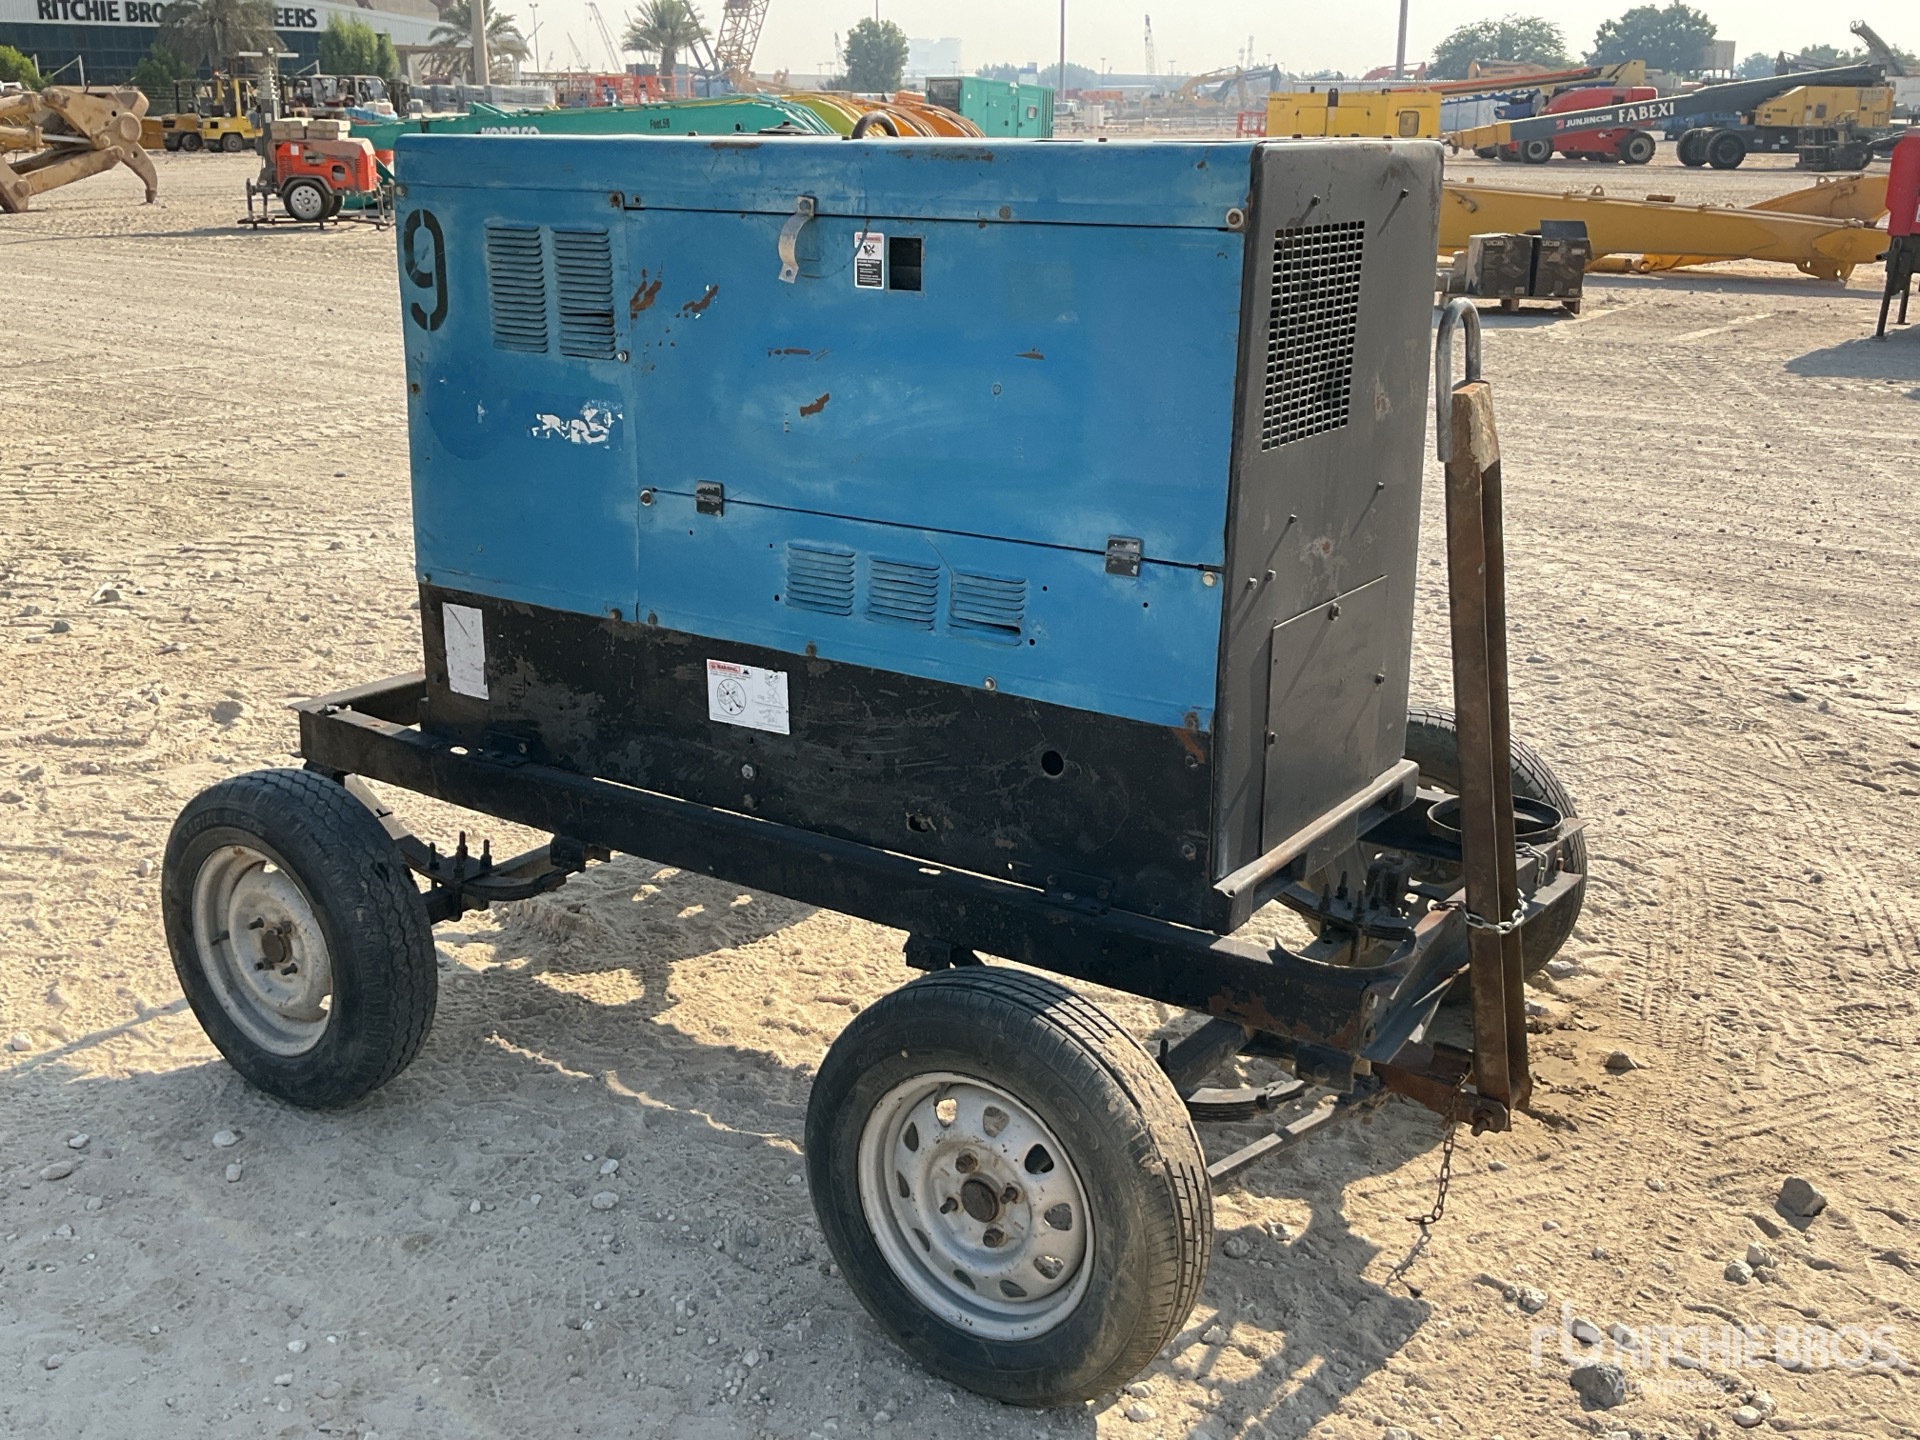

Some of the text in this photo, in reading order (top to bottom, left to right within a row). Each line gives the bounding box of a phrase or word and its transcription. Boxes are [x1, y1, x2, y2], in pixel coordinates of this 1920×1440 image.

[37, 0, 318, 28] RITCHIE BRO EERS
[1618, 101, 1675, 123] FABEXI
[403, 208, 448, 332] 9
